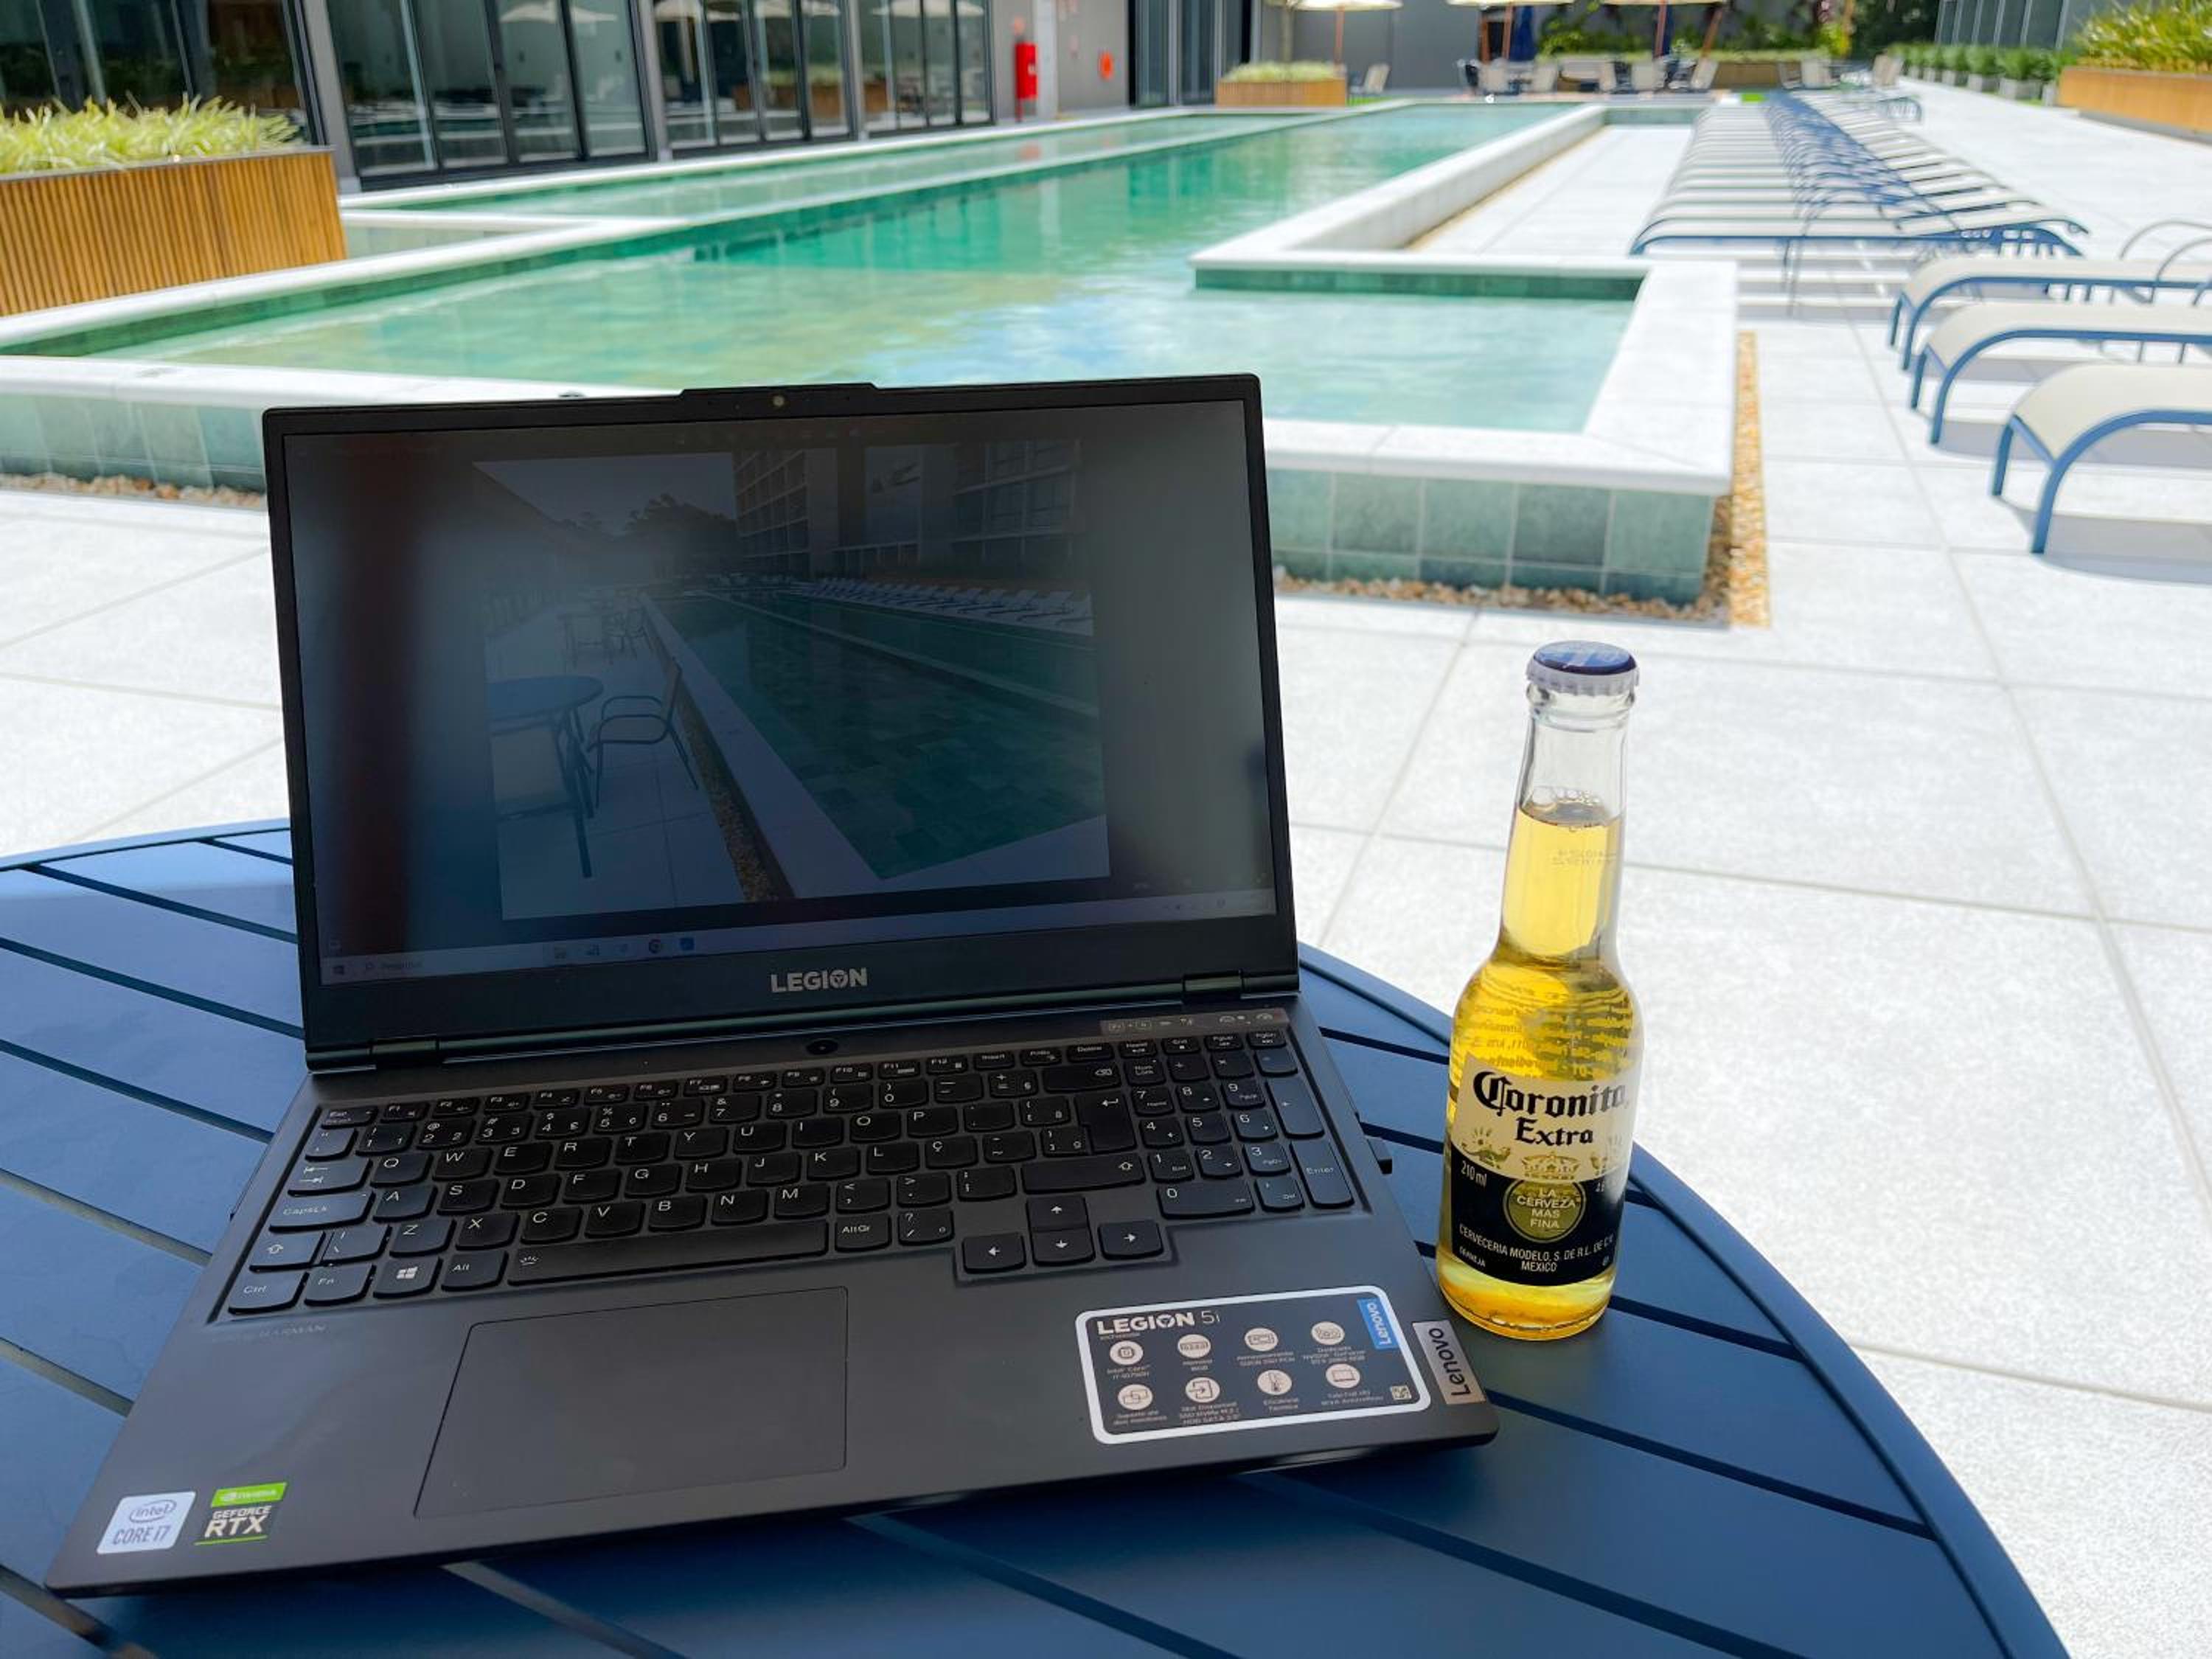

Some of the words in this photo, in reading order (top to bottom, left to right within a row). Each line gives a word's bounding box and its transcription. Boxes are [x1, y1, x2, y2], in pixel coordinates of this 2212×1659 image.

[771, 967, 867, 993] LEGION
[1474, 1071, 1627, 1117] Coronita
[1515, 1116, 1594, 1147] Extra
[1539, 1188, 1557, 1197] LA
[1516, 1196, 1576, 1209] CERVEZA
[1531, 1208, 1561, 1218] MAS
[1529, 1218, 1560, 1229] FINA
[1459, 1223, 1508, 1256] CERVECERIA
[453, 1263, 470, 1271] Alt
[1520, 1261, 1558, 1273] MEXICO
[243, 1285, 267, 1293] Ctrl
[1096, 1312, 1196, 1335] LEGION
[1200, 1310, 1221, 1325] 5i
[1366, 1301, 1393, 1346] Lenovo
[1427, 1327, 1472, 1397] Lenovo
[212, 1505, 272, 1520] GEFORCE
[204, 1515, 267, 1539] RTX
[113, 1528, 152, 1545] CORE
